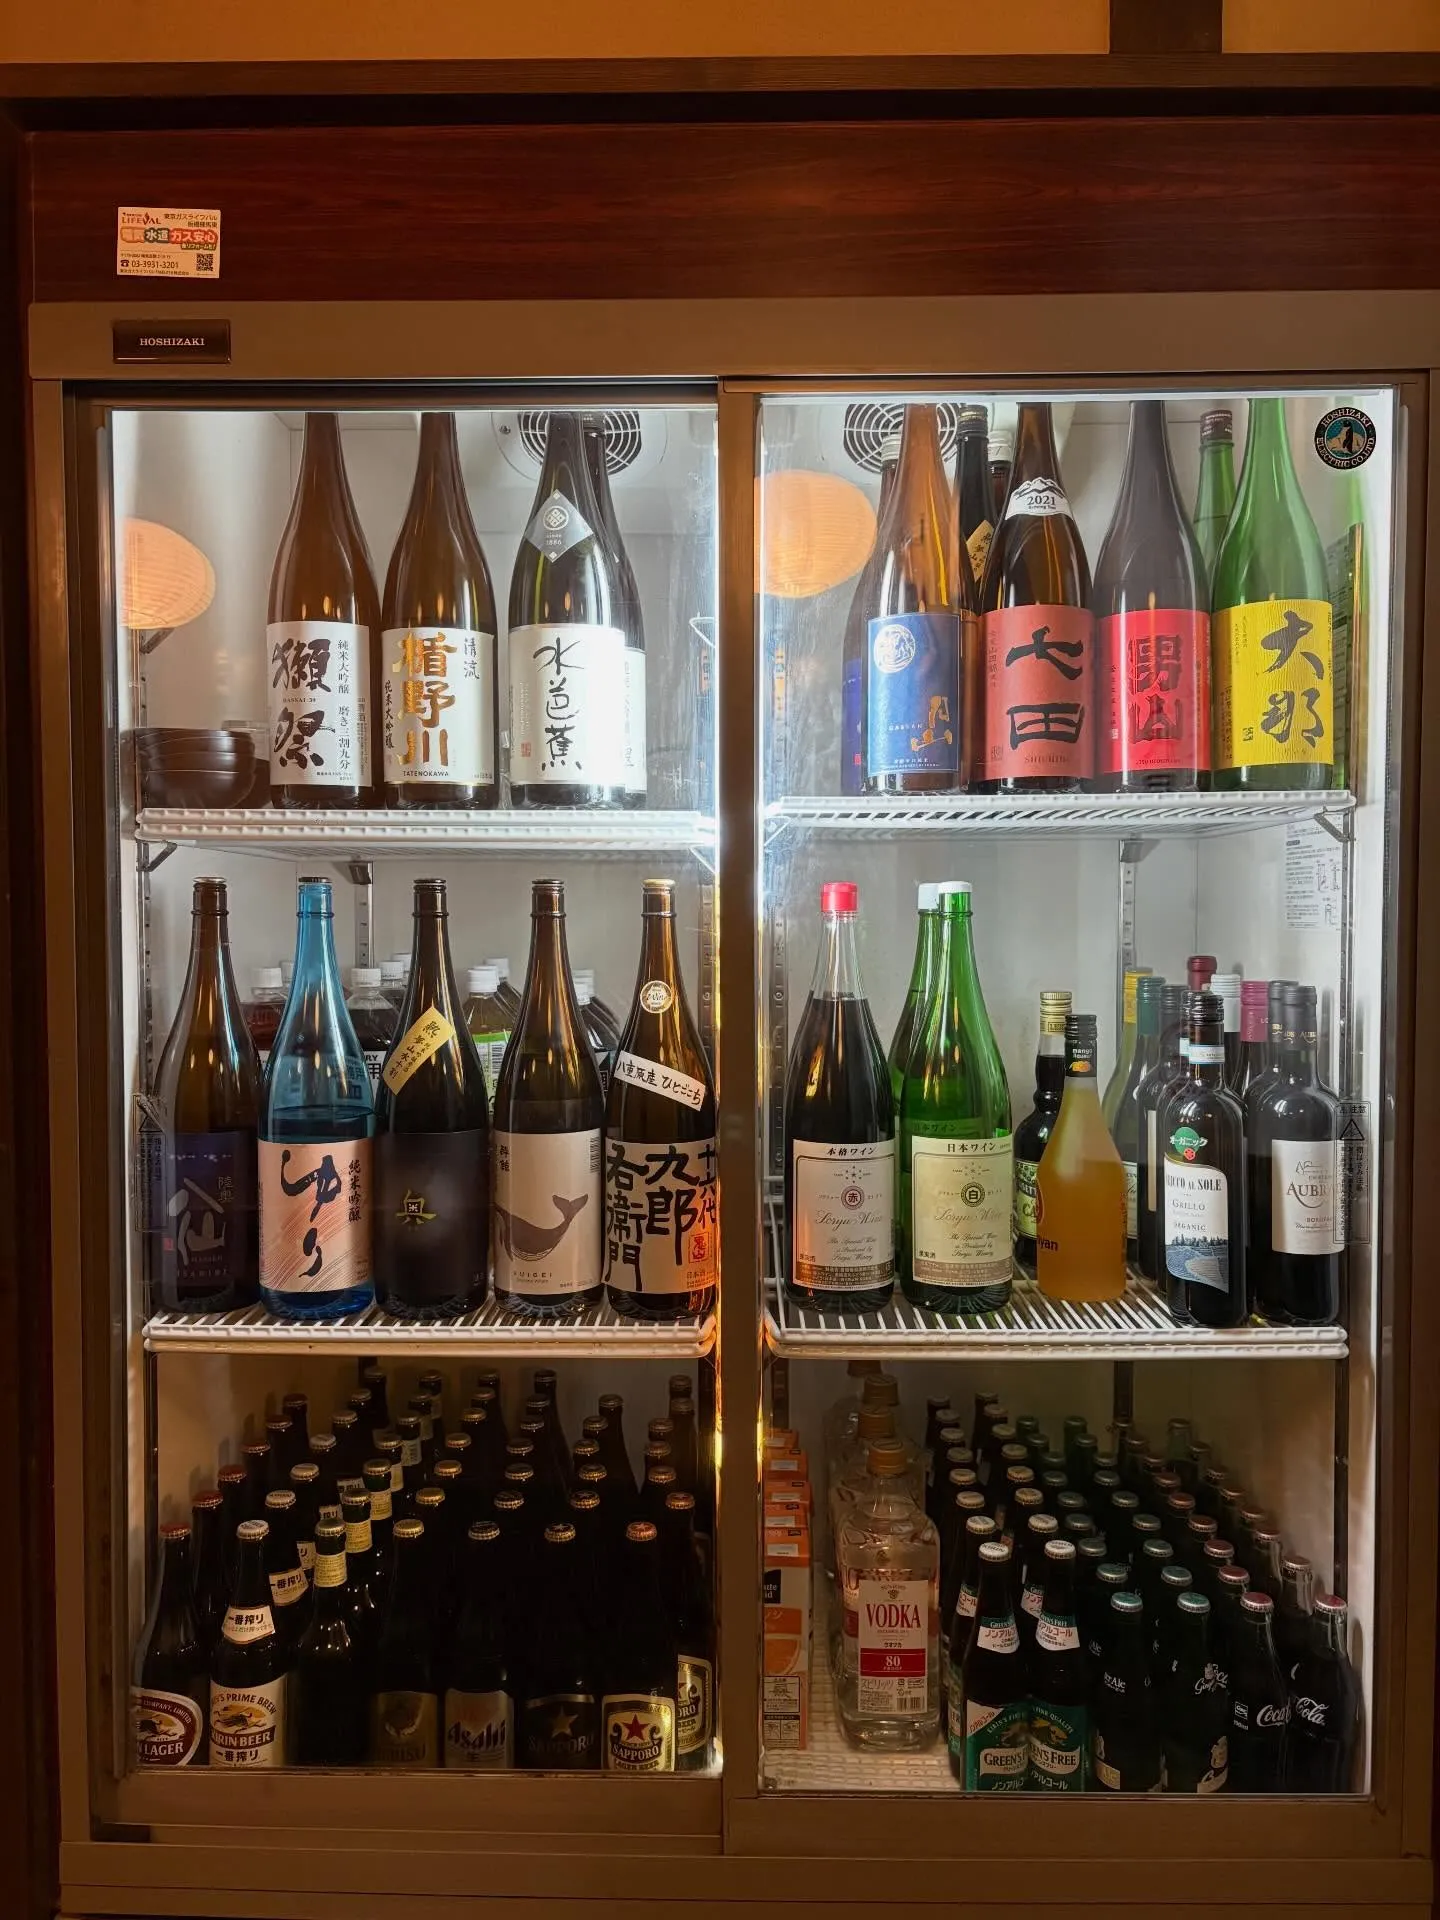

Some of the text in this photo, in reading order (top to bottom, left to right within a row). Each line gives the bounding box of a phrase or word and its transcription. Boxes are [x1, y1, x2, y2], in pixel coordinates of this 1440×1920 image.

[122, 212, 161, 225] LIFEVAL
[131, 261, 179, 269] 03-3931-3201
[139, 338, 205, 346] HOSHIZAKI
[1320, 408, 1373, 428] HOSHIZAKI
[1317, 437, 1350, 467] ELECTRIC
[1027, 494, 1056, 506] 2021
[463, 636, 480, 680] 清流
[1260, 610, 1326, 749] 大那
[1005, 626, 1085, 751] 七田
[1128, 634, 1184, 745] 男山
[271, 638, 336, 770] 獺祭
[391, 631, 458, 766] 楯野川
[533, 637, 585, 772] 水芭蕉
[337, 704, 351, 770] 磨き三割九分
[403, 770, 449, 778] TATENOKAWA
[662, 1074, 702, 1106] ひとごこち
[947, 1142, 996, 1153] 日本ワイン
[1169, 1135, 1208, 1148] オーガニック
[827, 1146, 877, 1156] 本格ワイン
[1197, 1178, 1222, 1191] SOLE
[848, 1192, 858, 1204] 赤
[968, 1189, 978, 1200] 白
[1172, 1199, 1206, 1211] GRILLO
[270, 1574, 302, 1590] 一番搾り
[228, 1613, 264, 1626] 一番搾り
[866, 1604, 921, 1629] VODKA
[885, 1655, 900, 1667] 80
[861, 1678, 894, 1690] スピリッツ
[227, 1693, 255, 1704] PRIME
[257, 1697, 278, 1715] BREW
[239, 1731, 271, 1747] BEER
[447, 1719, 506, 1750] Asahi
[144, 1741, 185, 1756] LAGER
[216, 1749, 260, 1762] 一番搾り
[613, 1744, 660, 1761] SAPPORO
[1050, 1752, 1076, 1766] FREE
